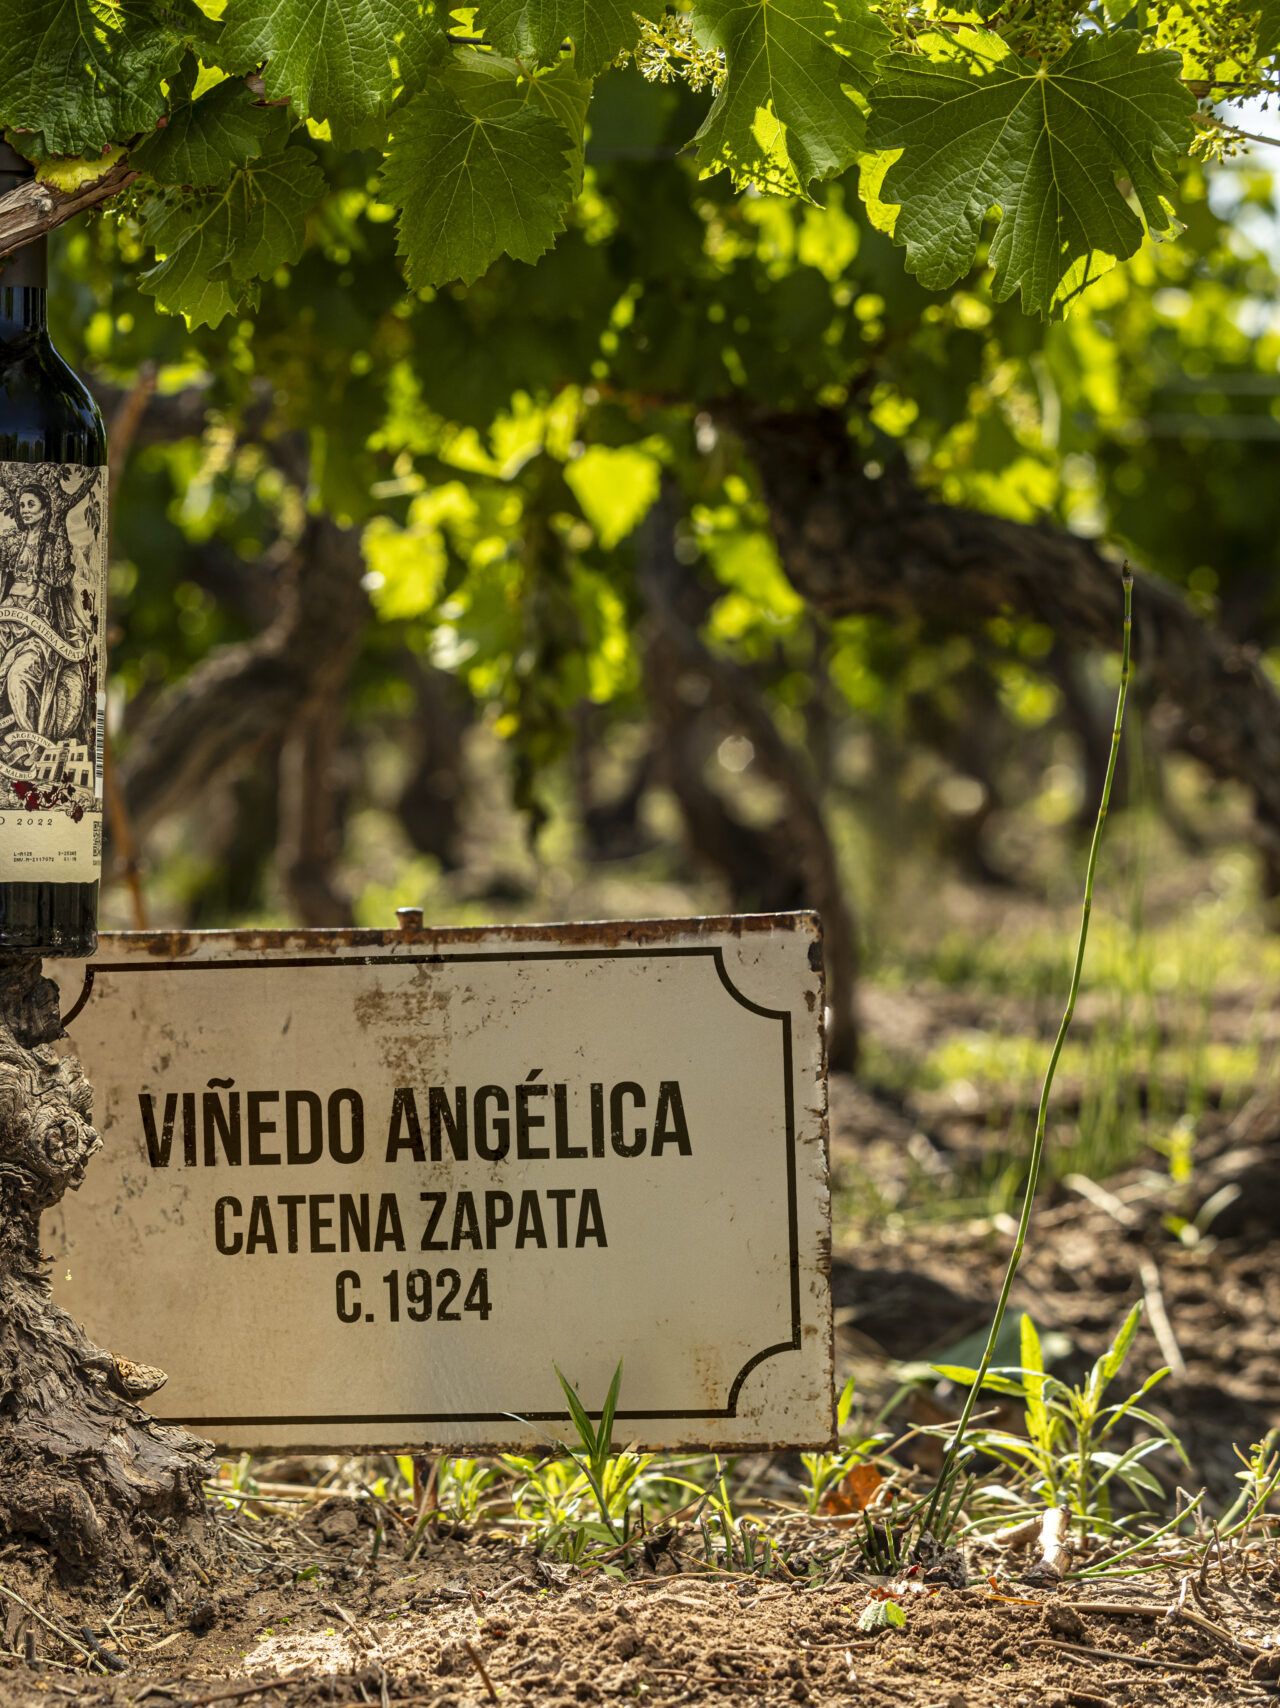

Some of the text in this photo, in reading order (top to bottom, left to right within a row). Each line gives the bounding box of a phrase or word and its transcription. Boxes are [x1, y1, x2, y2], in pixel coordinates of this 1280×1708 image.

[31, 619, 58, 646] CATENA
[11, 732, 54, 749] ARGENTINE
[5, 767, 33, 779] MALBEC
[16, 818, 53, 826] 2022
[138, 1069, 692, 1168] VIÑEDO ANGÉLICA
[215, 1189, 608, 1255] CATENA ZAPATA
